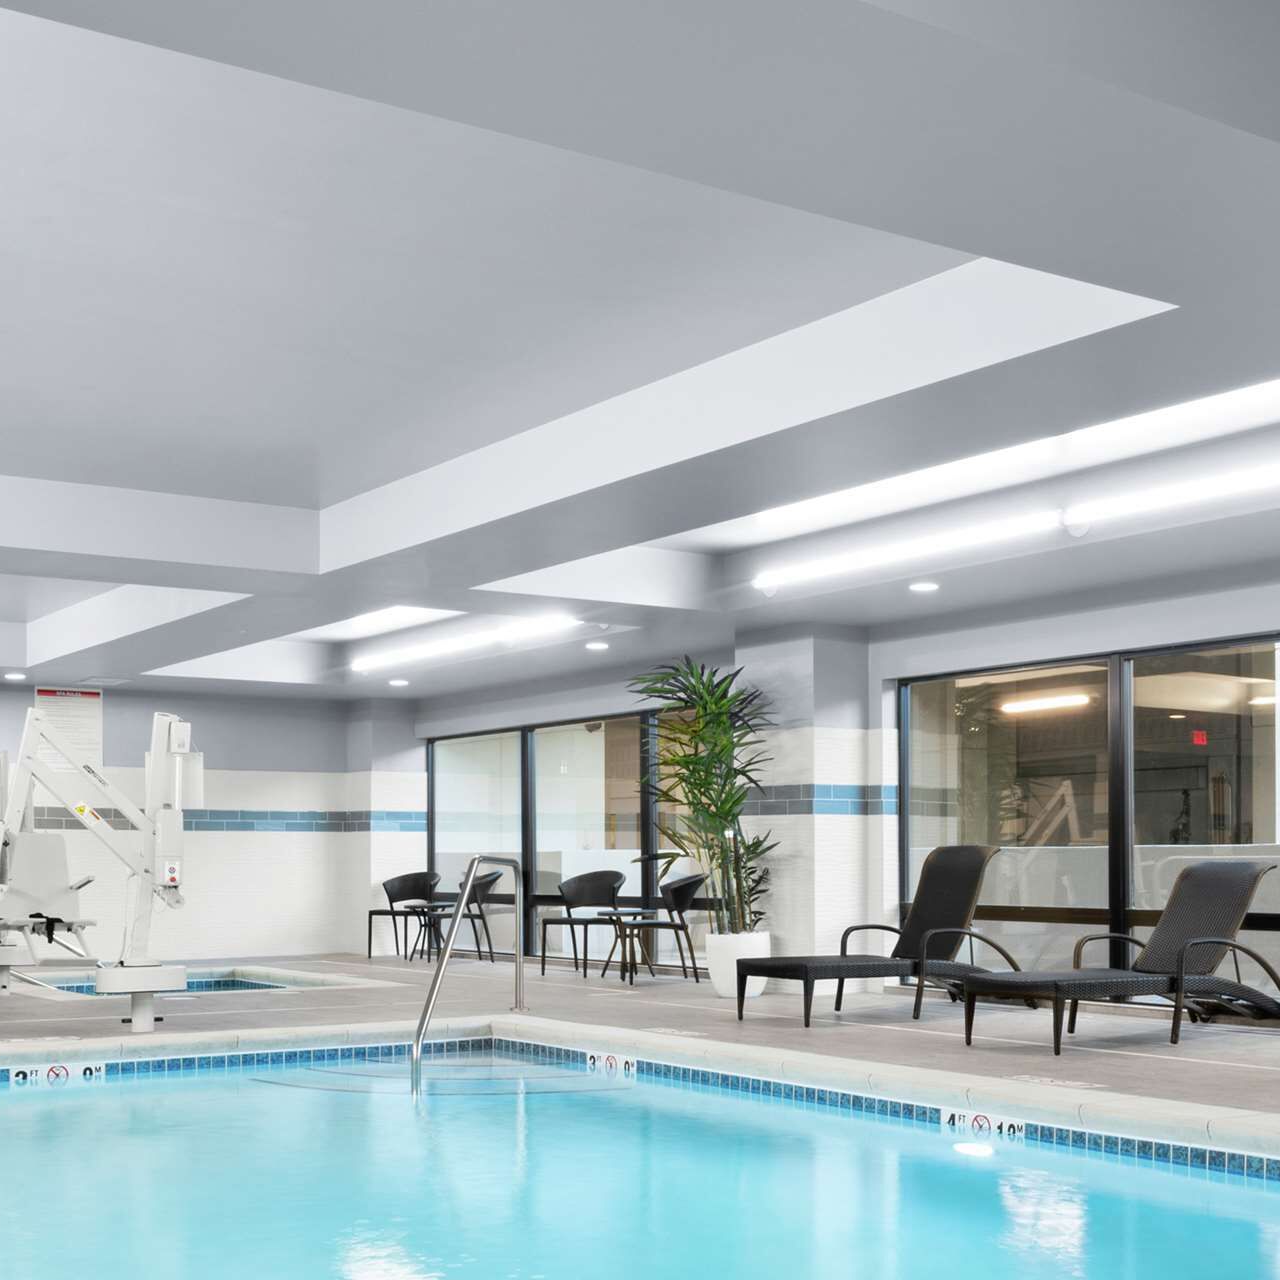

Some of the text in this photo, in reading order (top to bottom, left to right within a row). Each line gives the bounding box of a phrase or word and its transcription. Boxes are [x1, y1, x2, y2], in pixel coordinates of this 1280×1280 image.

[947, 1113, 966, 1126] 4 FT
[1017, 1124, 1024, 1134] M
